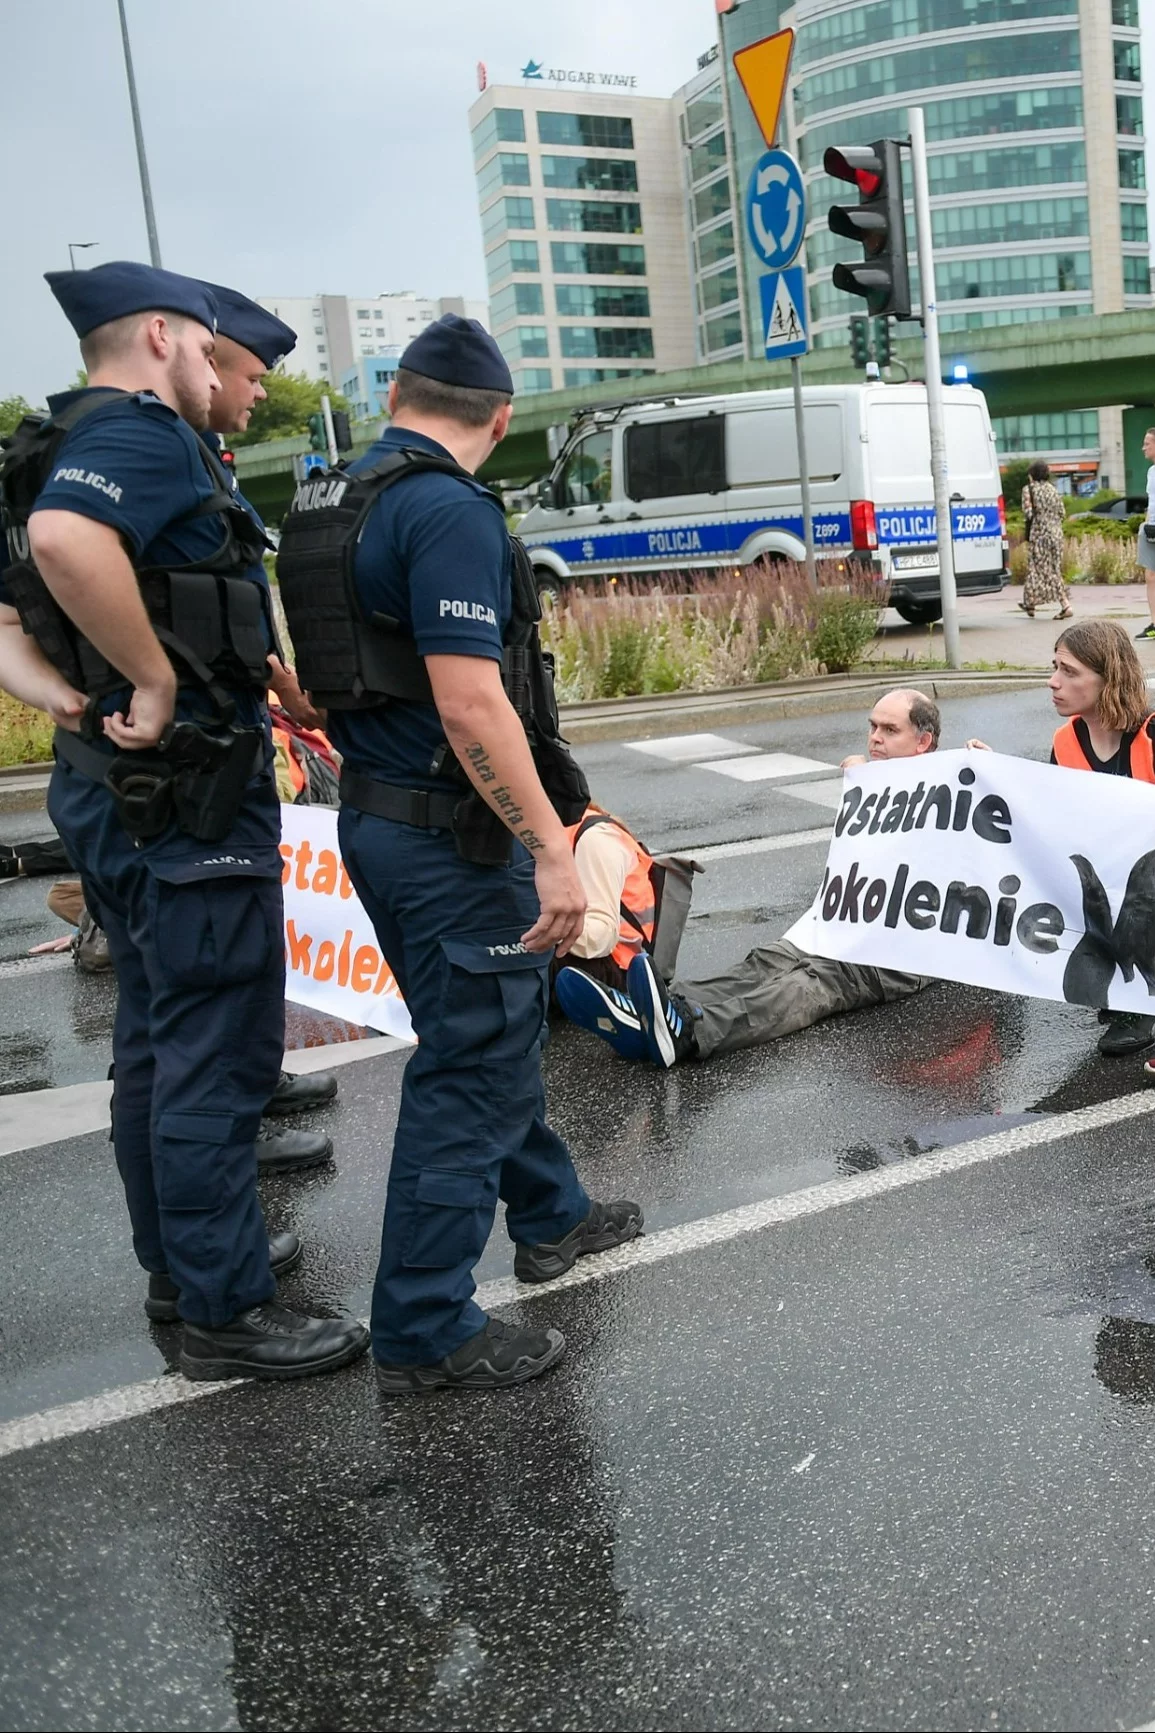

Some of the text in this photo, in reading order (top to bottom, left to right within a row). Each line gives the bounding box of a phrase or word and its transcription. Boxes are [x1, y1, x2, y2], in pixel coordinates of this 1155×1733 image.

[548, 68, 638, 88] ADGAR WAVE
[54, 467, 123, 504] POLICJA
[291, 480, 348, 513] POLICJA
[815, 523, 841, 538] Z899
[956, 514, 986, 532] Z899
[649, 530, 701, 552] POLICJA
[439, 599, 497, 627] POLICJA
[835, 767, 1013, 844] Ostatnie
[519, 828, 547, 852] est
[278, 840, 357, 900] stat
[820, 862, 1065, 954] okolenie
[485, 942, 528, 957] POLIC
